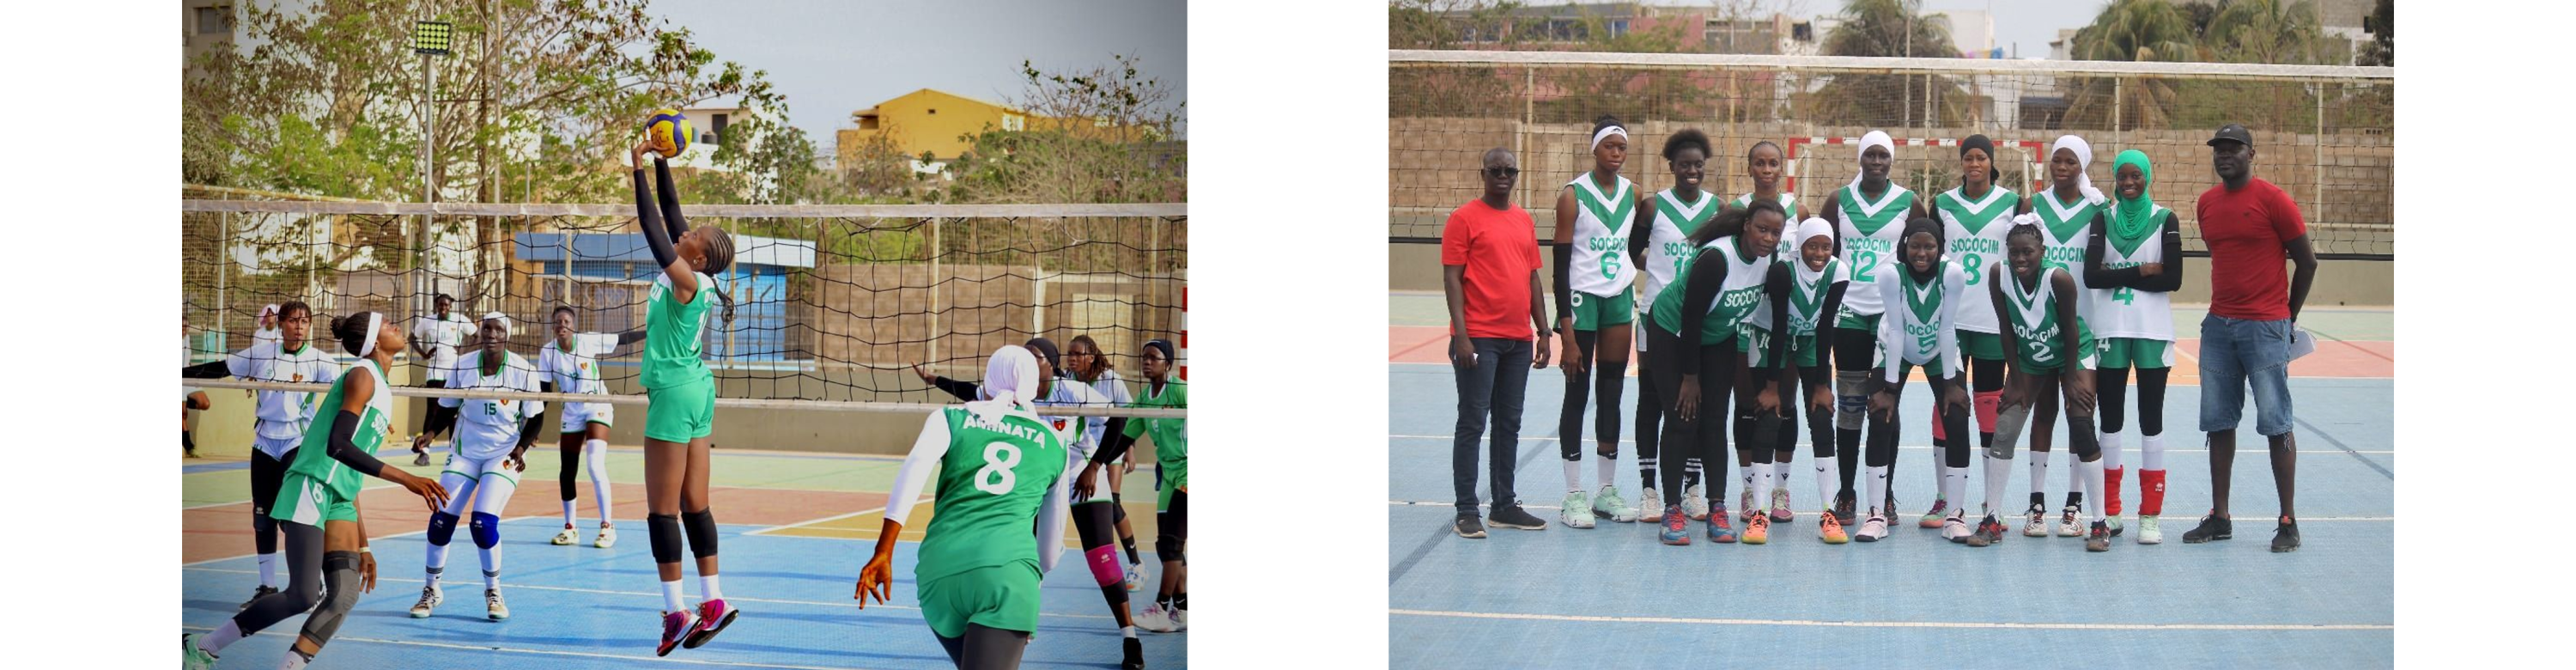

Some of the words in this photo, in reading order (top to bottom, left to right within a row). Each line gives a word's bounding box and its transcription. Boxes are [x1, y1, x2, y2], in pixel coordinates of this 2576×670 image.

[1951, 237, 2000, 254] SOCOCIM
[1601, 252, 1621, 280] 6
[1850, 250, 1877, 283] 12
[1963, 253, 1982, 286] 8
[2112, 285, 2134, 306] 4
[1917, 333, 1937, 355] 5
[2028, 341, 2054, 362] 2
[2098, 338, 2111, 352] 4
[483, 403, 497, 415] 15
[975, 442, 1022, 495] 8
[313, 483, 325, 504] 6
